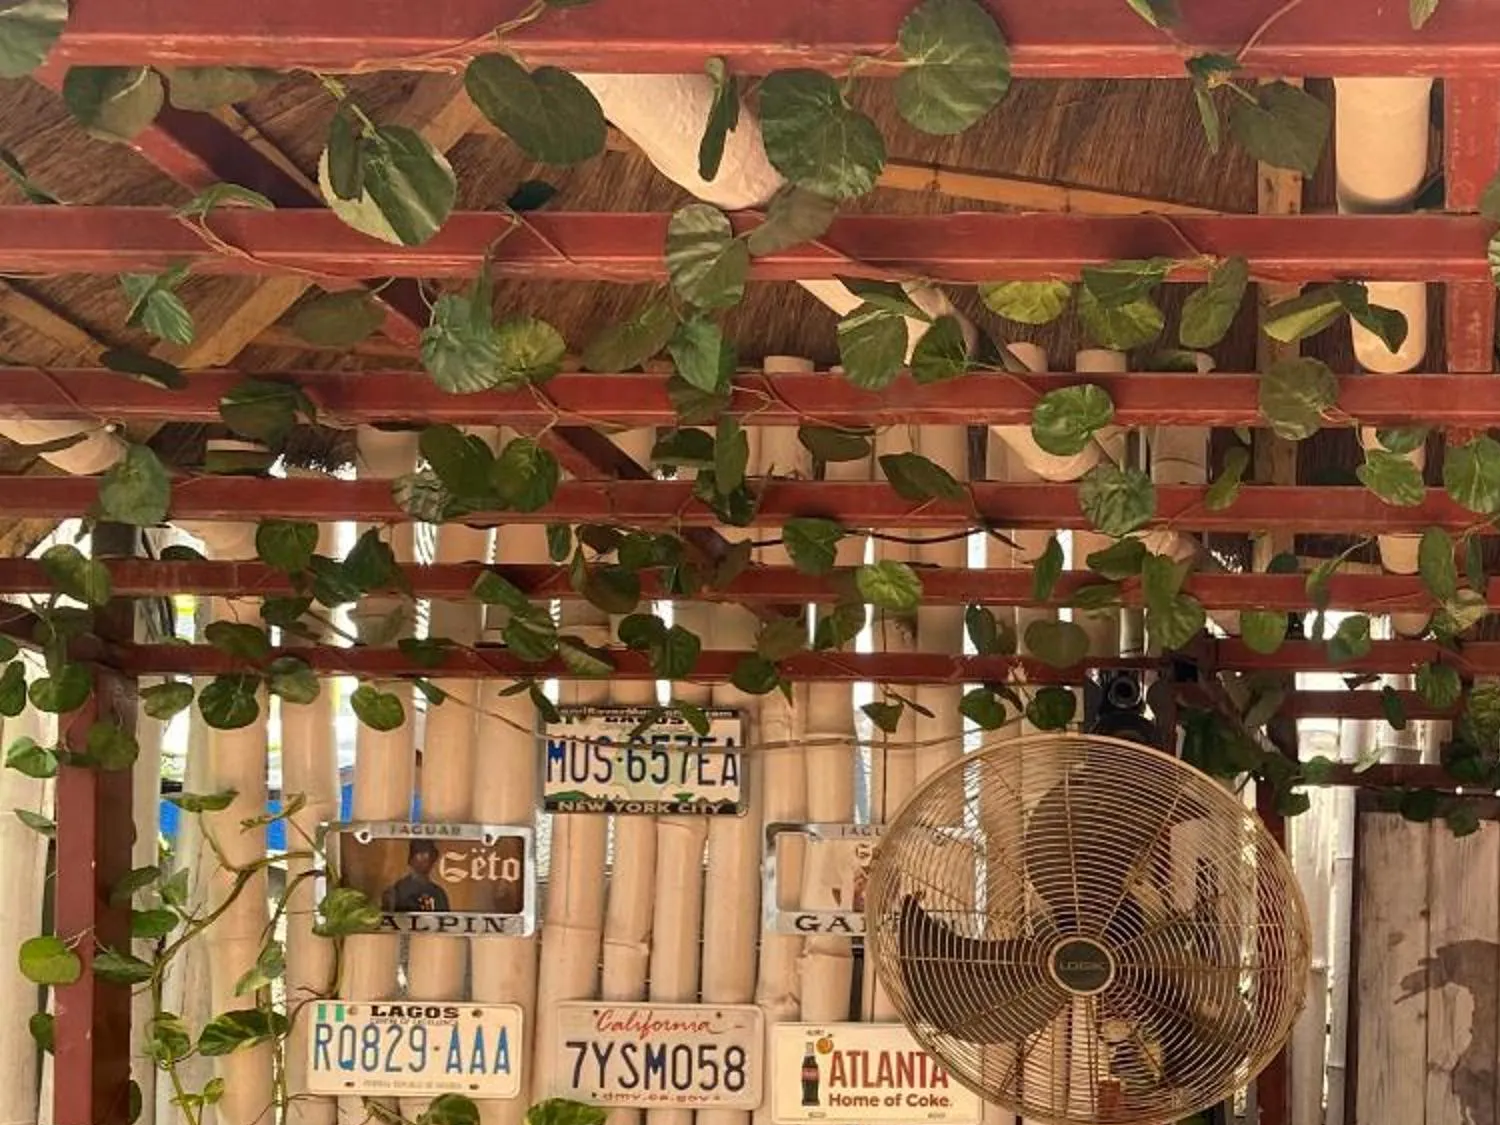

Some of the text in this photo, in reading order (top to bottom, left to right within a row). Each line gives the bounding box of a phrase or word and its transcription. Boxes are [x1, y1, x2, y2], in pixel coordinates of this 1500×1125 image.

[558, 801, 722, 813] NEW YORK CITY
[390, 825, 461, 836] JAGUAR
[373, 915, 508, 933] ALPIN
[371, 1005, 460, 1019] LAGOS
[595, 1009, 724, 1039] California
[565, 1040, 746, 1092] 7YSM058
[828, 1050, 949, 1089] ATLANTA
[602, 1091, 709, 1102] dmv.ca.gov
[828, 1093, 953, 1107] Home of Coke.
